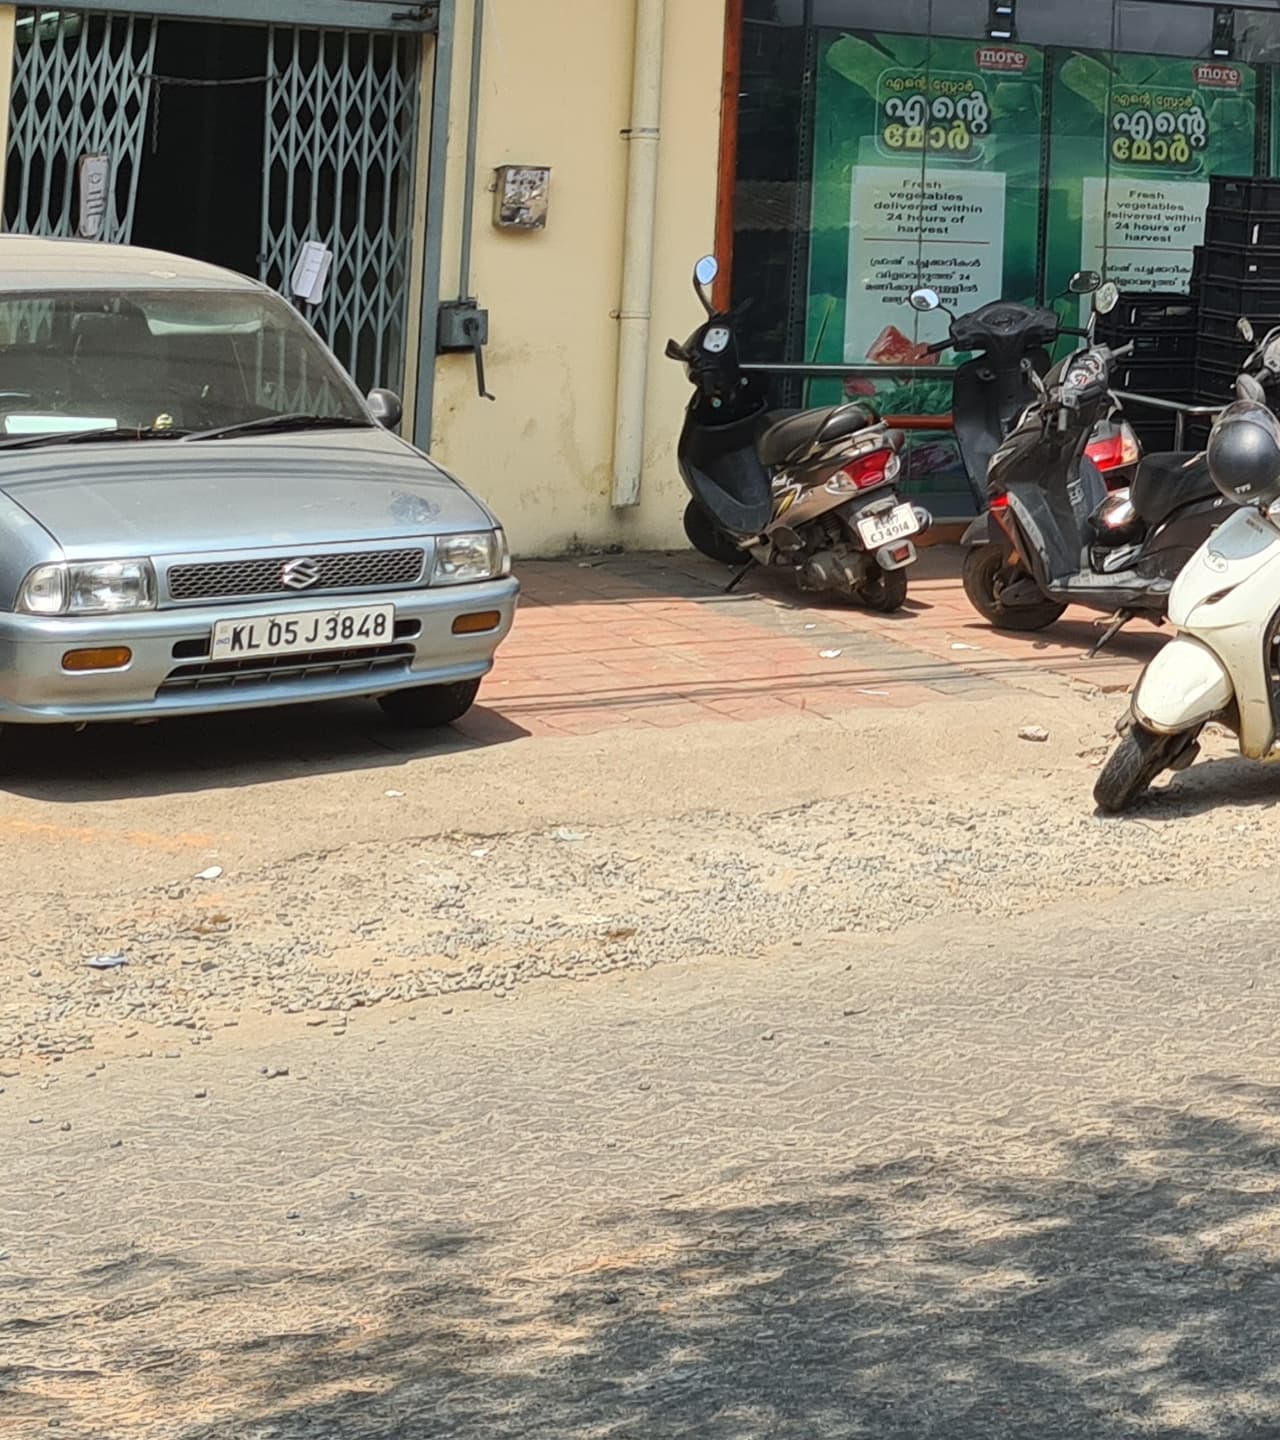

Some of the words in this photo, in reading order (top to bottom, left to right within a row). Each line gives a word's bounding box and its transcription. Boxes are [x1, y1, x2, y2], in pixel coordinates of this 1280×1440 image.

[980, 50, 1025, 64] more
[1198, 66, 1238, 80] more
[889, 192, 964, 201] vegetables
[1129, 190, 1165, 200] Fresh
[874, 201, 938, 212] delivered
[941, 203, 983, 213] within
[1116, 202, 1185, 211] vegetables
[886, 213, 903, 221] 24
[907, 214, 947, 223] hours
[951, 215, 965, 224] of
[1165, 214, 1202, 223] within
[897, 224, 949, 234] harvest
[1115, 222, 1129, 230] 24
[1134, 222, 1170, 232] hours
[1173, 224, 1186, 232] of
[1125, 233, 1172, 243] harvest
[230, 624, 261, 652] KL
[267, 620, 299, 647] 05
[305, 618, 320, 643] J
[324, 613, 387, 641] 3848
